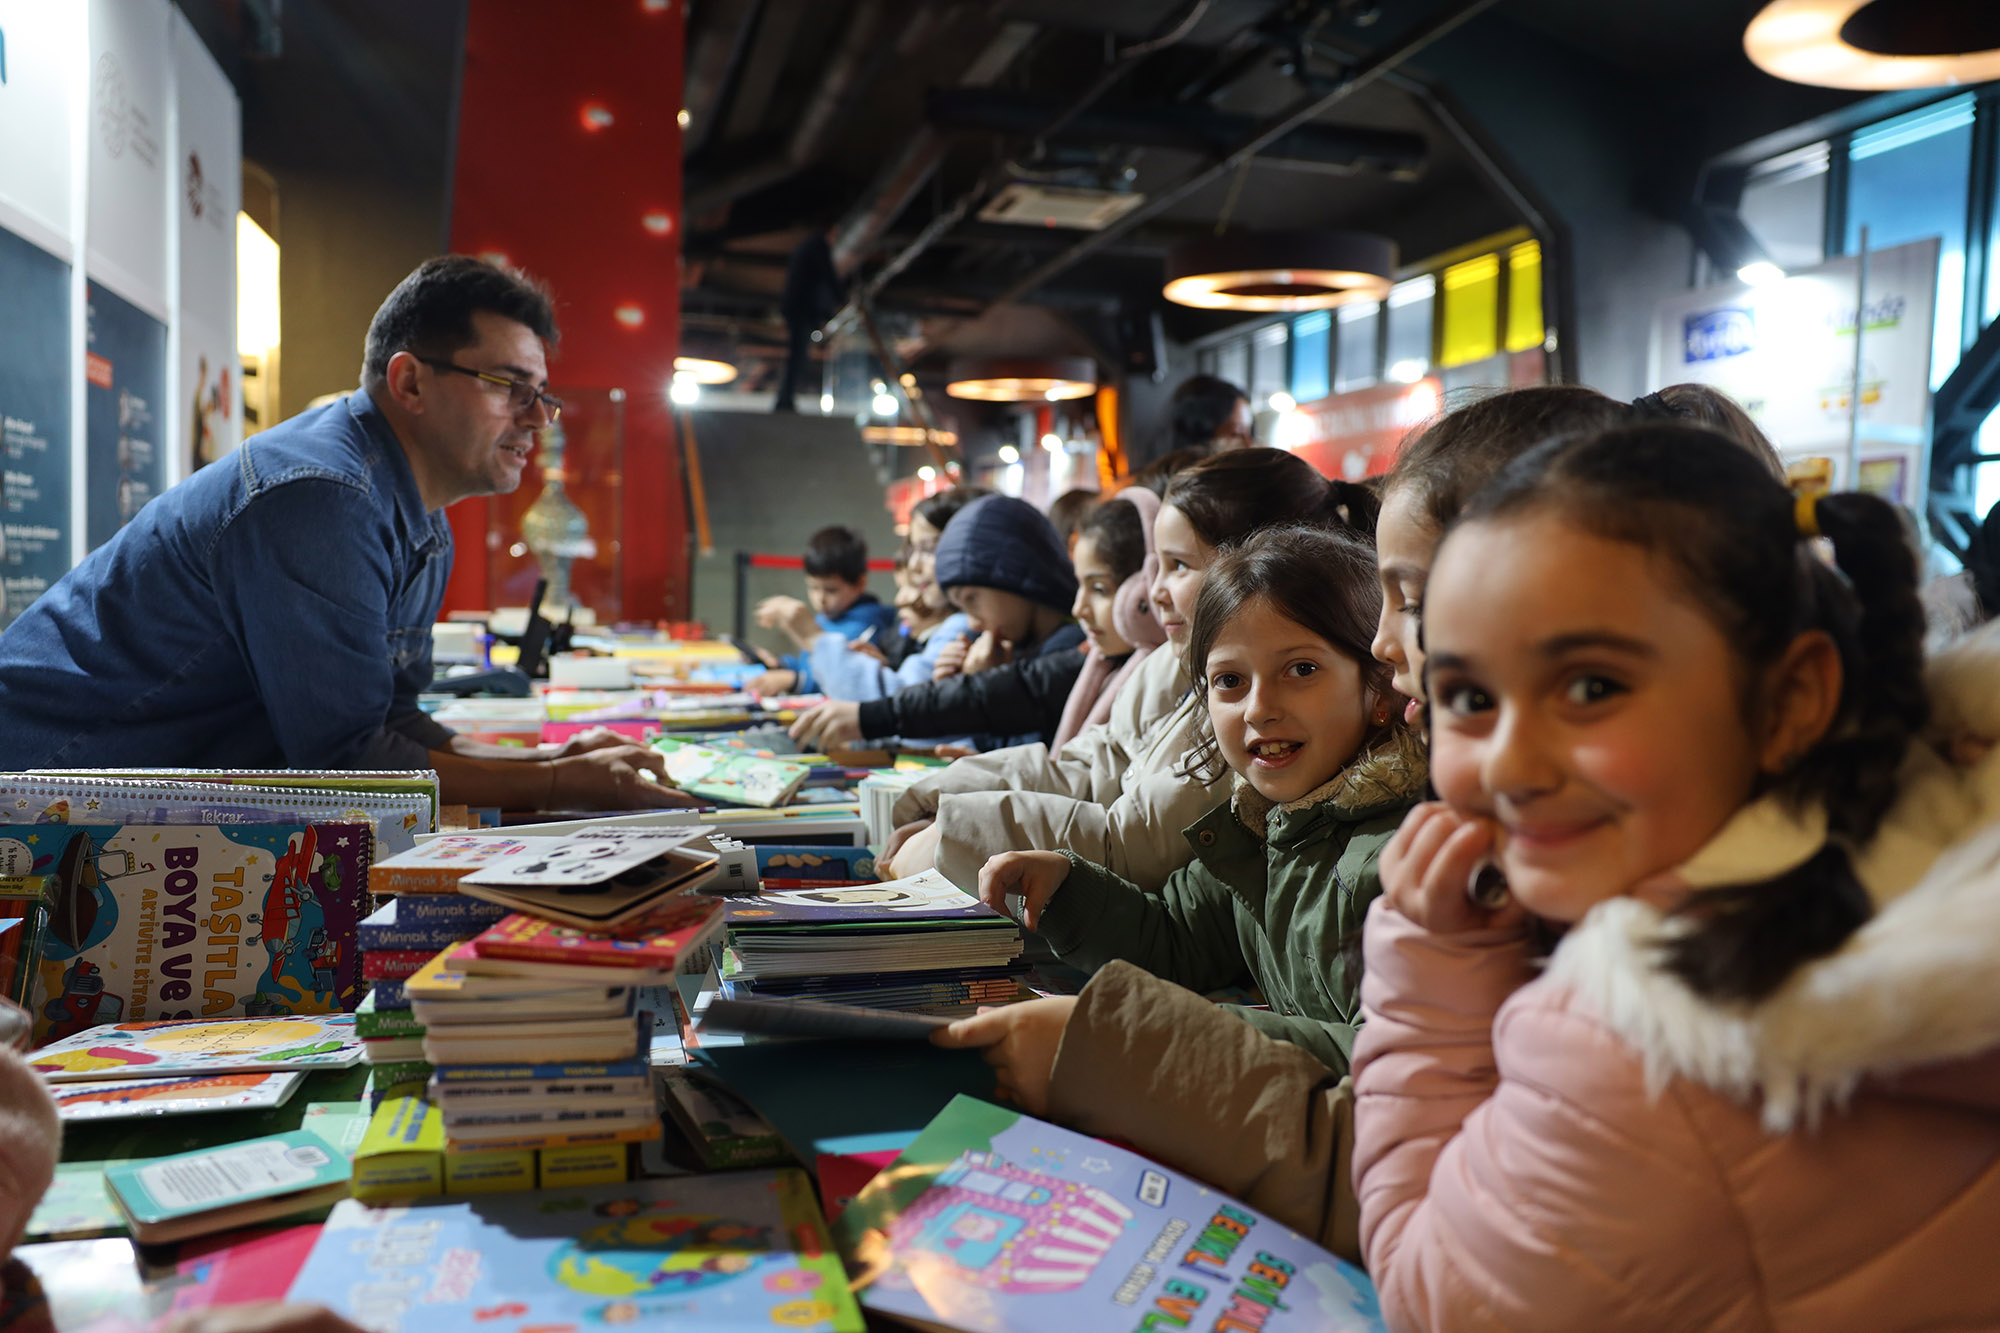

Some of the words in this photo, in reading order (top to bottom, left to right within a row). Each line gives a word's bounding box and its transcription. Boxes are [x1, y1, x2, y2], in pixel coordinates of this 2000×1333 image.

[162, 846, 198, 949] BOYA
[389, 873, 437, 887] Minnak
[135, 888, 160, 965] AKTİVİTE
[416, 902, 465, 919] Minnak
[470, 903, 505, 915] Serisi
[200, 866, 245, 1017] TAŞITLA
[379, 929, 428, 944] Minnak
